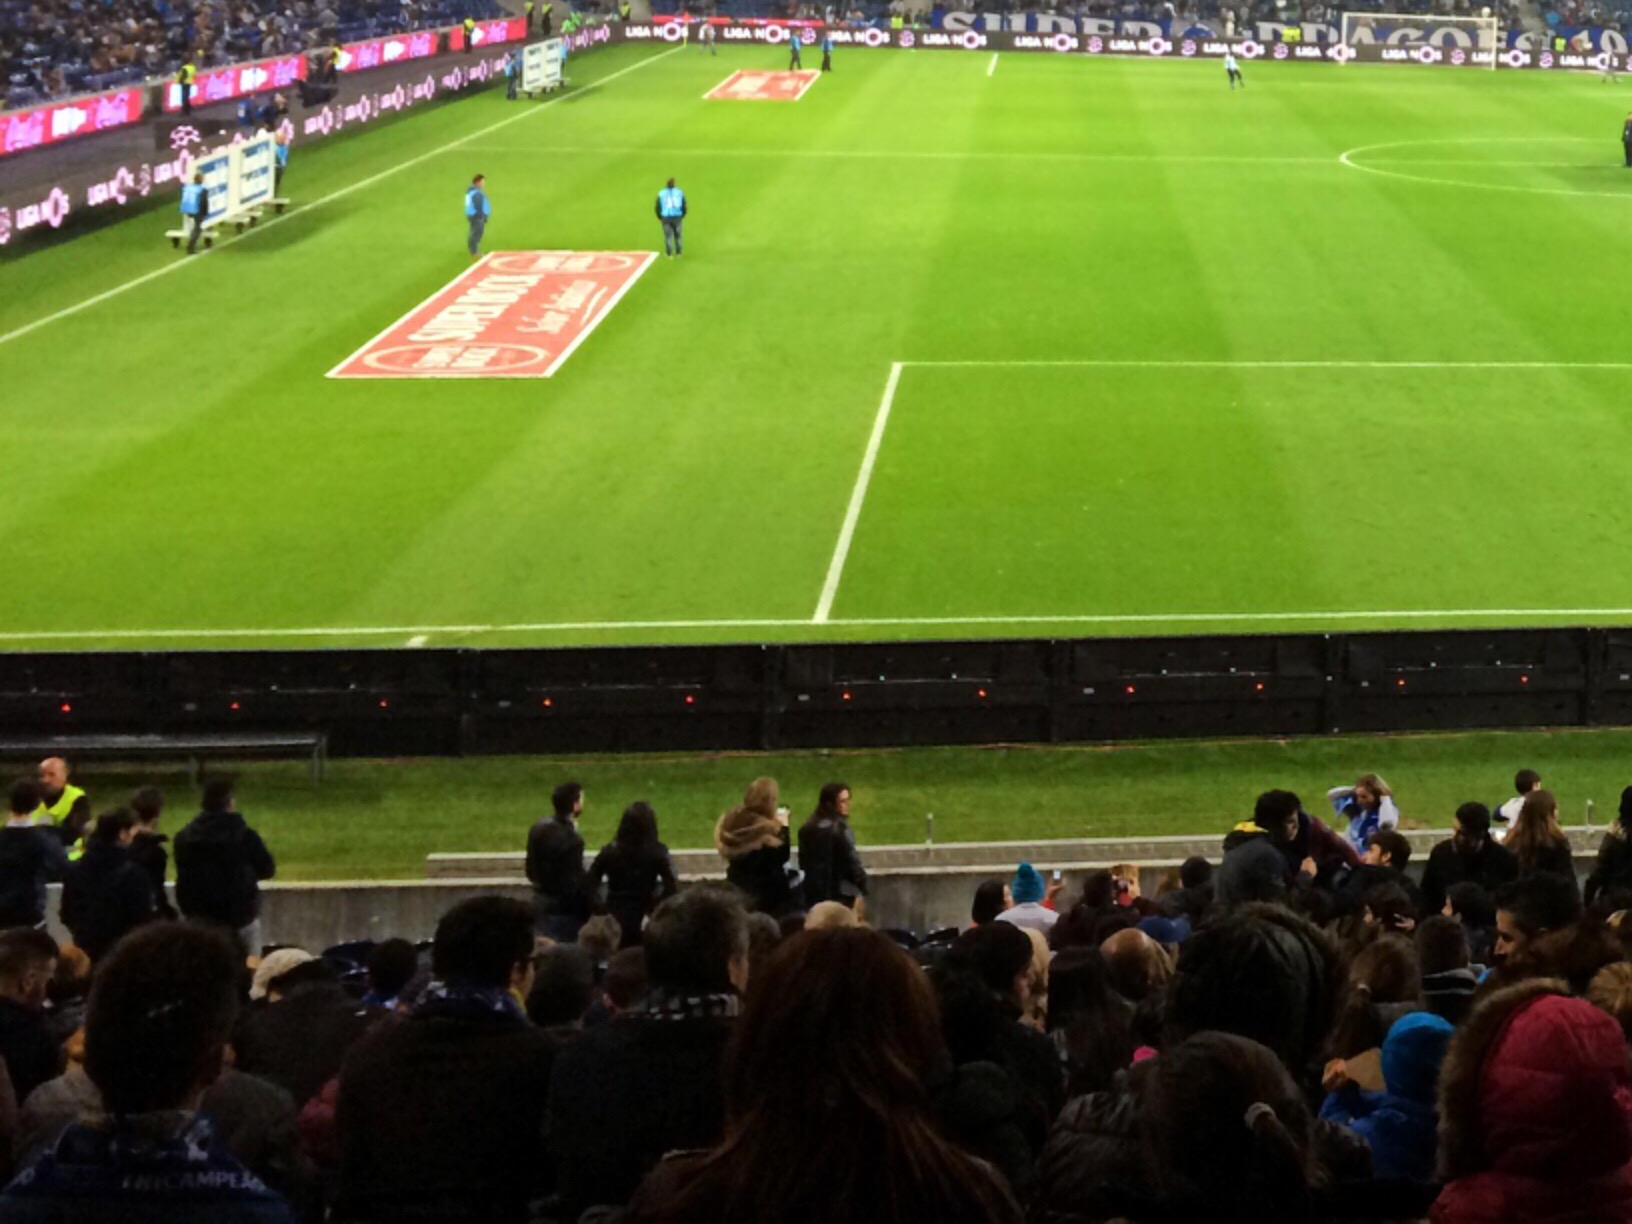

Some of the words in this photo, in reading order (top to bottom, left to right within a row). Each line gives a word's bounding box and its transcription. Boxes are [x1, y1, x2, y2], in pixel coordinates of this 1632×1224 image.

[626, 26, 650, 38] LIGA
[653, 22, 688, 41] NOS
[724, 27, 752, 39] LIGA
[755, 25, 790, 43] NOS
[855, 28, 890, 46] NOS
[923, 33, 949, 45] LIGA
[952, 31, 987, 49] NOS
[1014, 36, 1042, 48] LIGA
[1044, 33, 1078, 52] NOS
[1109, 40, 1136, 51] LIGA
[1138, 37, 1173, 55] NOS
[1203, 41, 1229, 53] LIGA
[1231, 40, 1265, 58] NOS
[1295, 46, 1321, 57] LIGA
[1382, 49, 1408, 60] LIGA
[1410, 46, 1442, 63] NOS
[1499, 49, 1530, 67] NOS
[1560, 54, 1585, 66] LIGA
